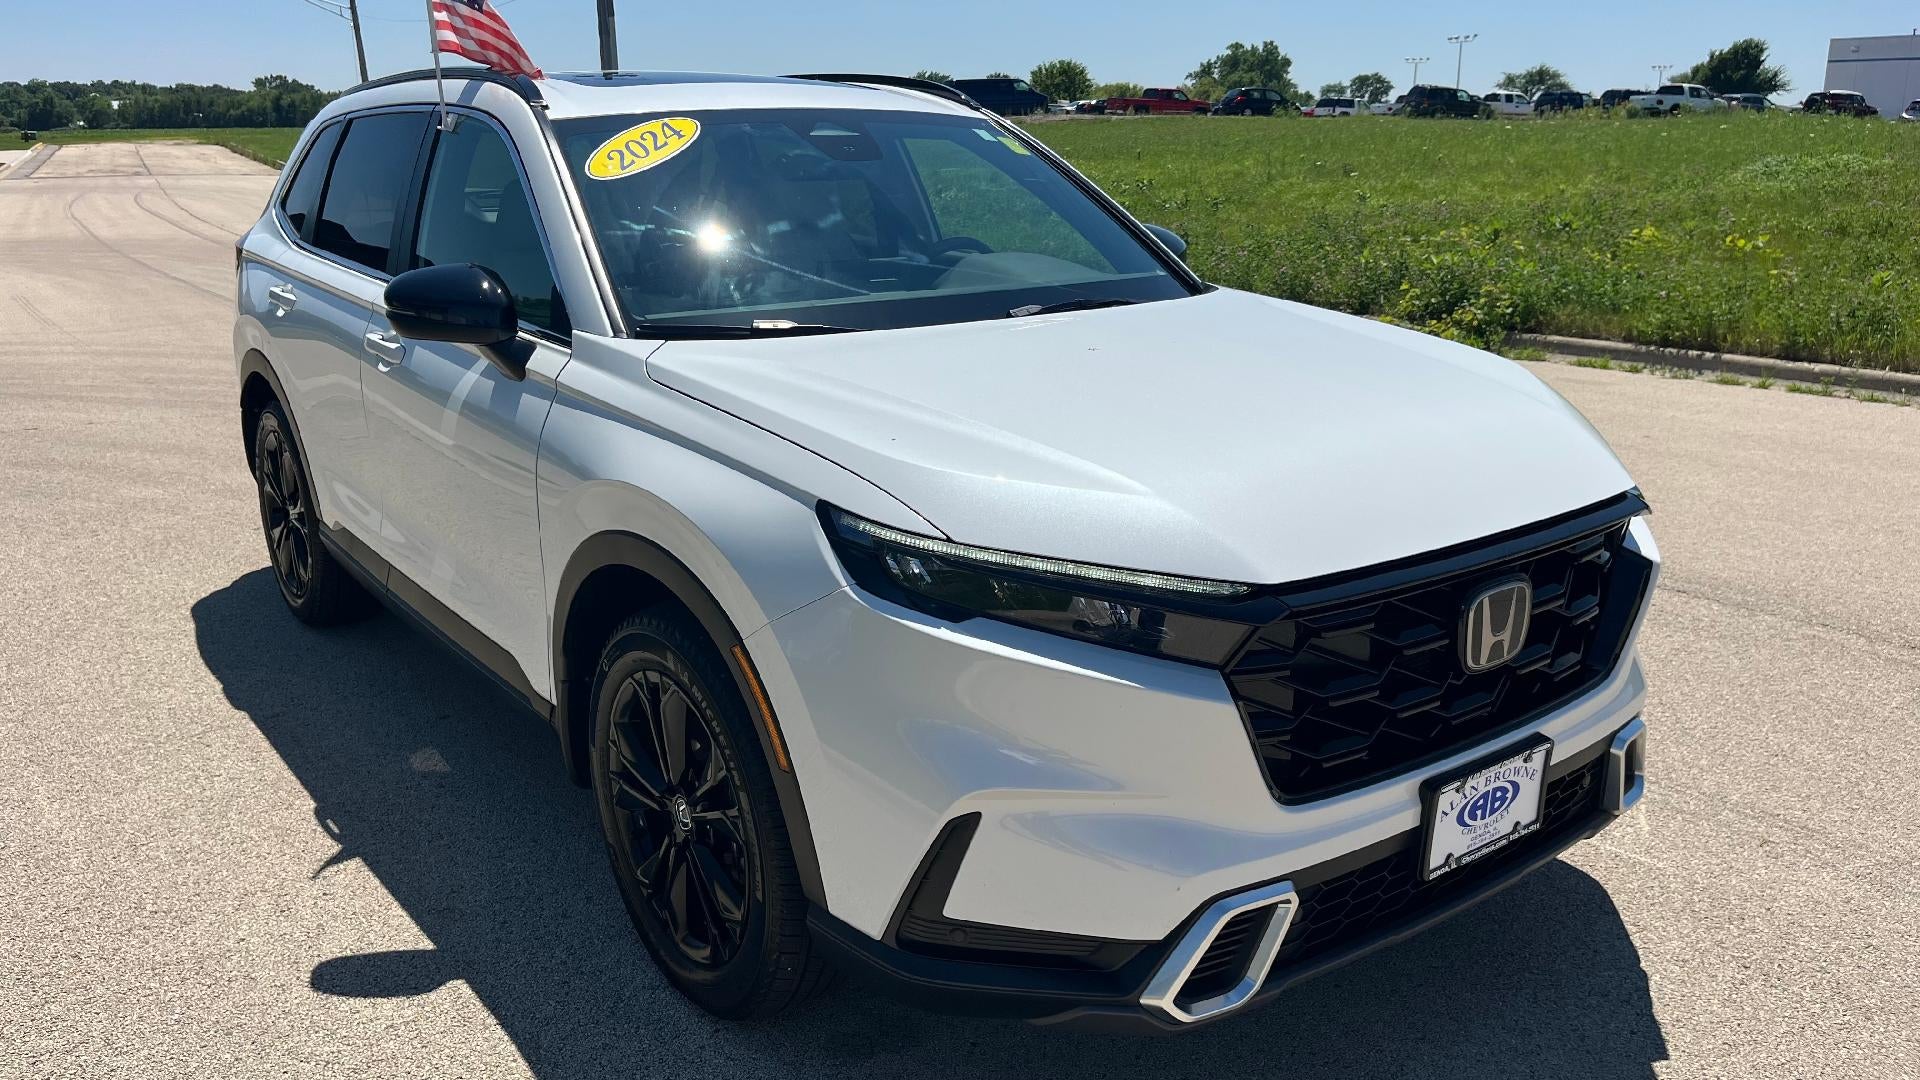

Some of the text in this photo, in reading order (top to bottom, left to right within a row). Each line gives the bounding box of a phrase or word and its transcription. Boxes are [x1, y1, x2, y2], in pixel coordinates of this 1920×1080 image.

[606, 121, 687, 172] 2024
[1440, 781, 1480, 822] ALAN
[1484, 766, 1538, 787] BROWNE
[1467, 785, 1510, 822] AB
[1462, 809, 1510, 835] CHEVROLET
